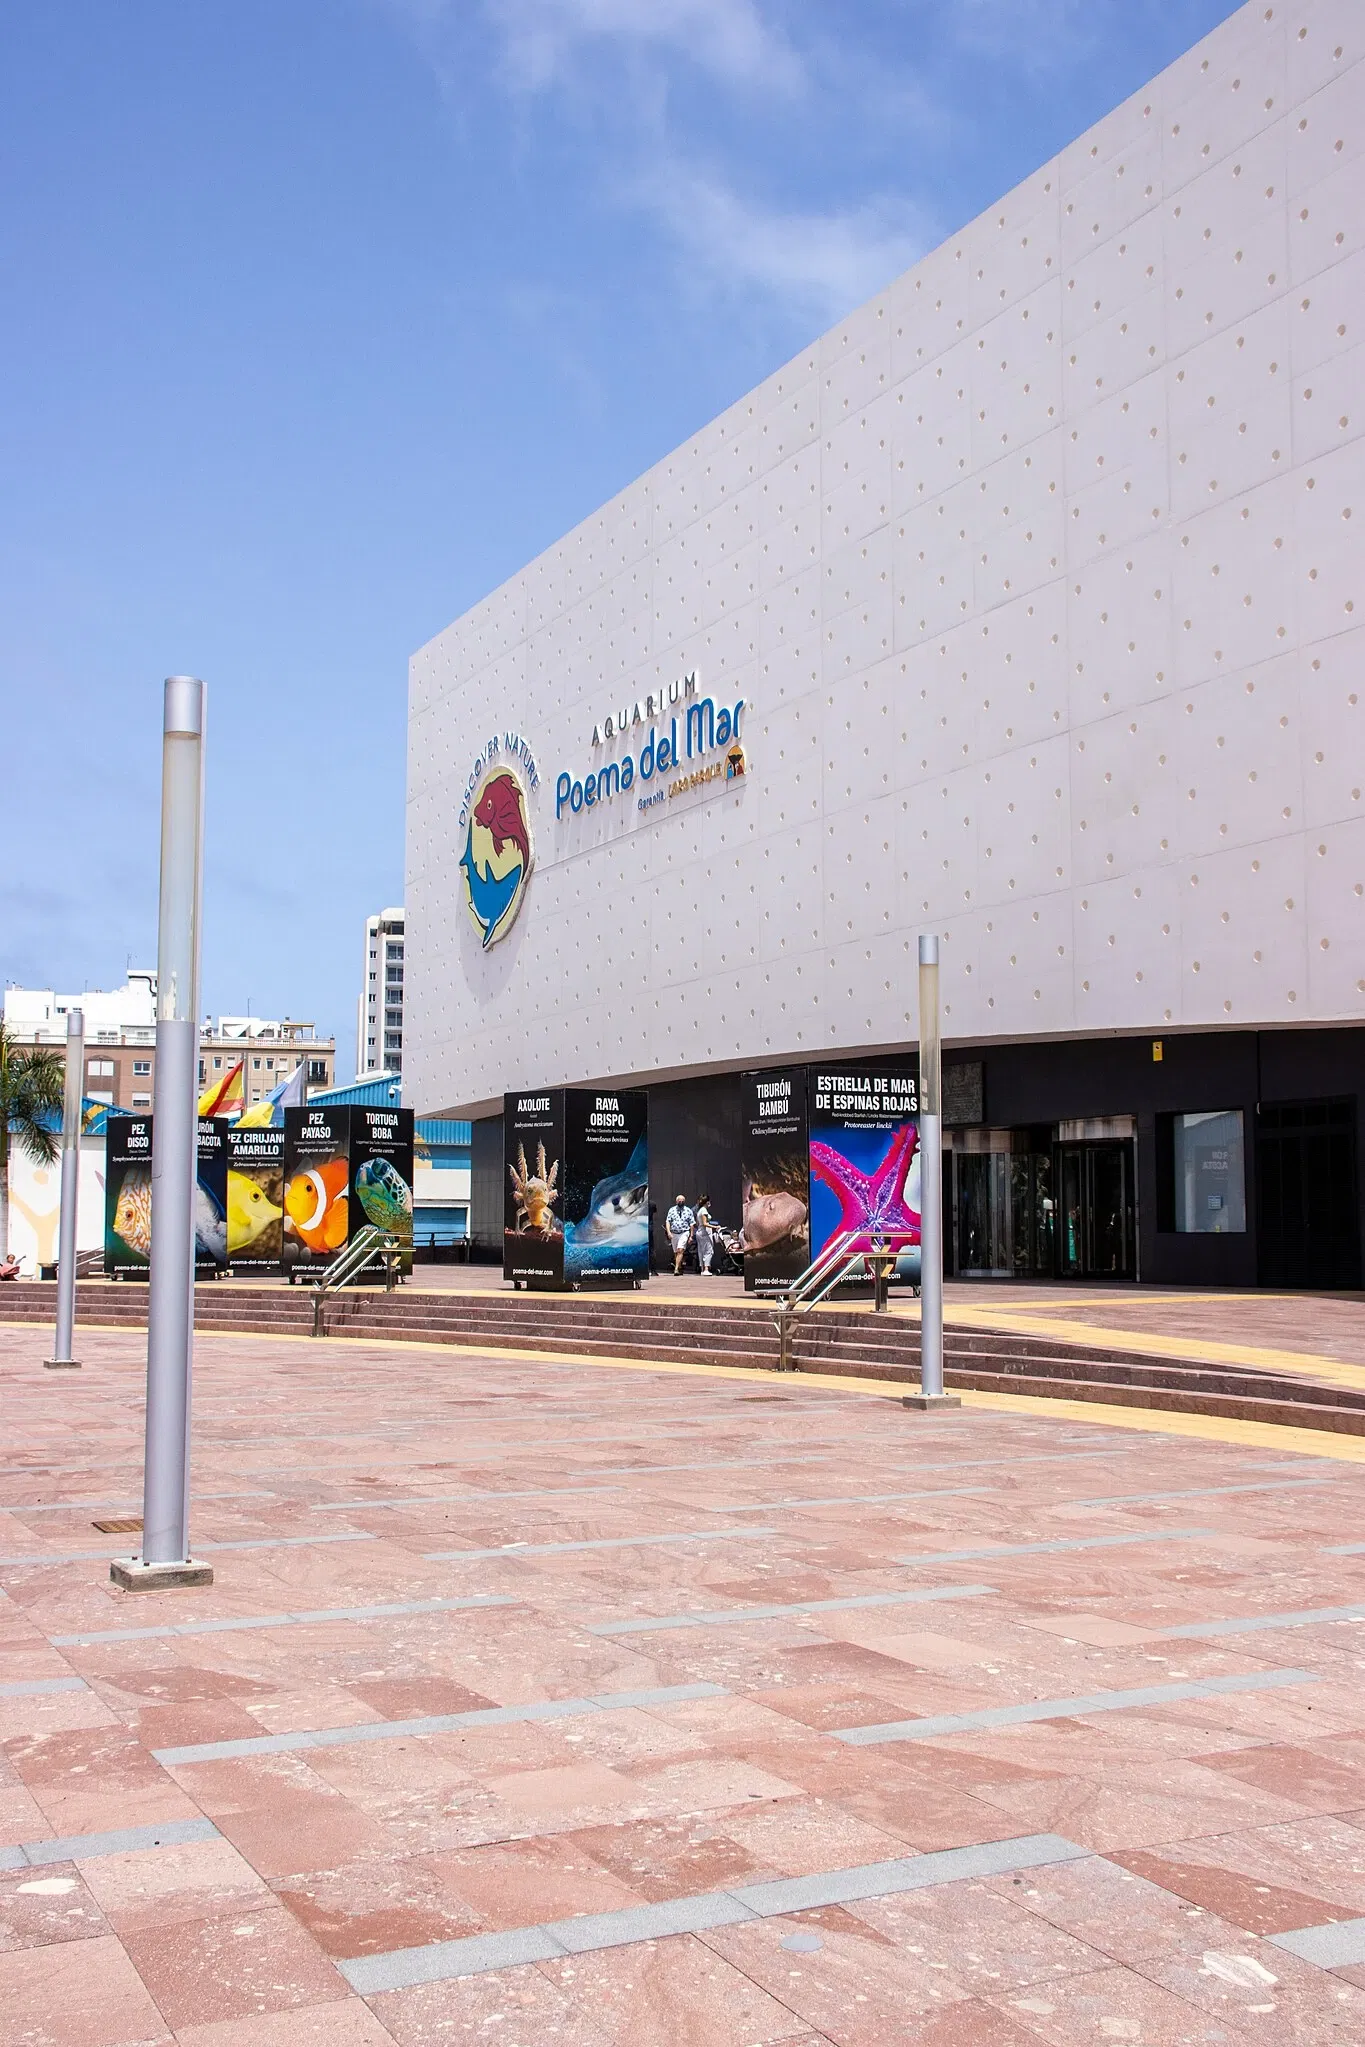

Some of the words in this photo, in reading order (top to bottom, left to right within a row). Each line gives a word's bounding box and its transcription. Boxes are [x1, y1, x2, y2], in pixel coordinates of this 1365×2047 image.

[591, 671, 698, 747] AQUARIUM
[556, 755, 635, 820] Poema
[639, 716, 680, 780] del
[686, 697, 747, 759] Mar
[458, 735, 500, 827] DISCOVER
[504, 732, 541, 792] NATURE
[756, 1079, 791, 1099] TIBURÓN
[817, 1075, 872, 1092] ESTRELLA
[873, 1078, 889, 1093] DE
[890, 1079, 916, 1094] MAR
[517, 1097, 551, 1112] AXOLOTE
[595, 1097, 620, 1111] RAYA
[759, 1096, 789, 1116] BAMBÚ
[815, 1094, 831, 1109] DE
[833, 1095, 880, 1111] ESPINAS
[882, 1096, 918, 1112] ROJAS
[309, 1113, 324, 1125] PEZ
[365, 1112, 399, 1126] TORTUGA
[590, 1113, 625, 1127] OBISPO
[131, 1123, 146, 1135] PEZ
[197, 1120, 214, 1134] URÓN
[301, 1126, 331, 1139] PAYASO
[372, 1127, 393, 1140] BOBA
[127, 1136, 149, 1148] DISCO
[233, 1144, 280, 1156] AMARILLO
[114, 1264, 151, 1272] poema-del-mar.c
[512, 1268, 554, 1276] poema-del-mar.com
[580, 1267, 634, 1277] poema-del-mar.com
[754, 1277, 797, 1286] poema-del-mar.co
